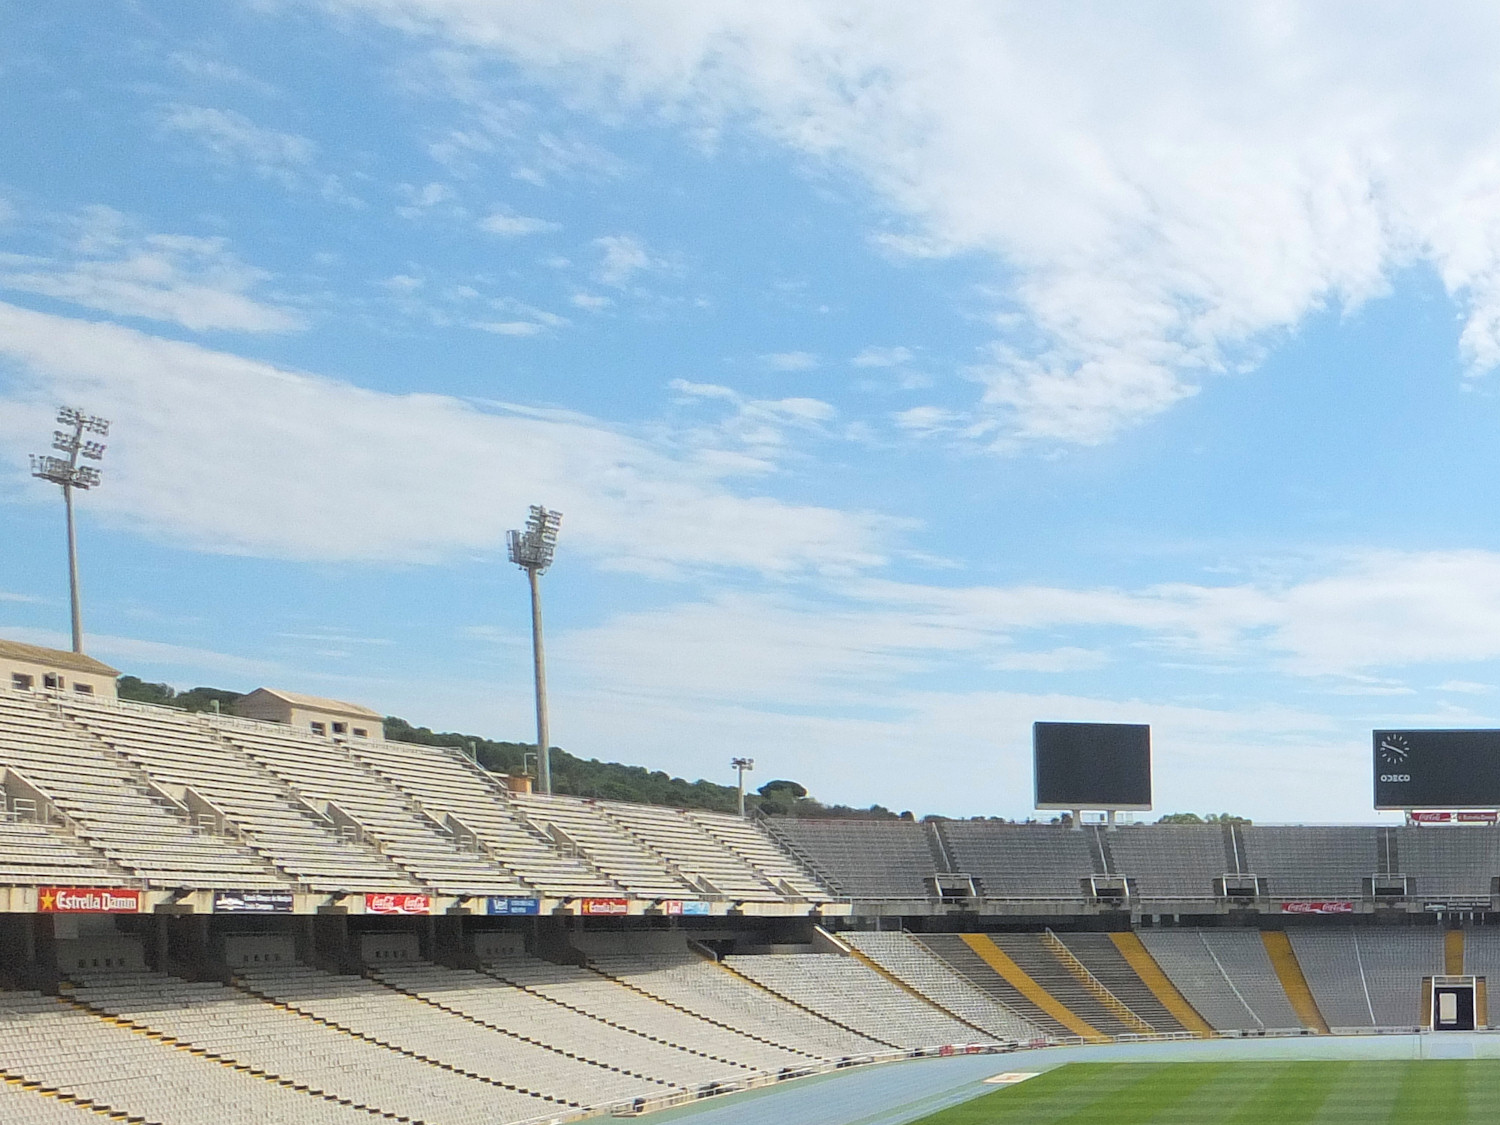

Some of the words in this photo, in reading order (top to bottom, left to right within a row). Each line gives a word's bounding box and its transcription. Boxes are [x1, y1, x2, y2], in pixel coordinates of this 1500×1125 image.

[1380, 774, 1410, 782] ODECO
[56, 891, 100, 909] Estrella
[101, 892, 137, 910] Damm
